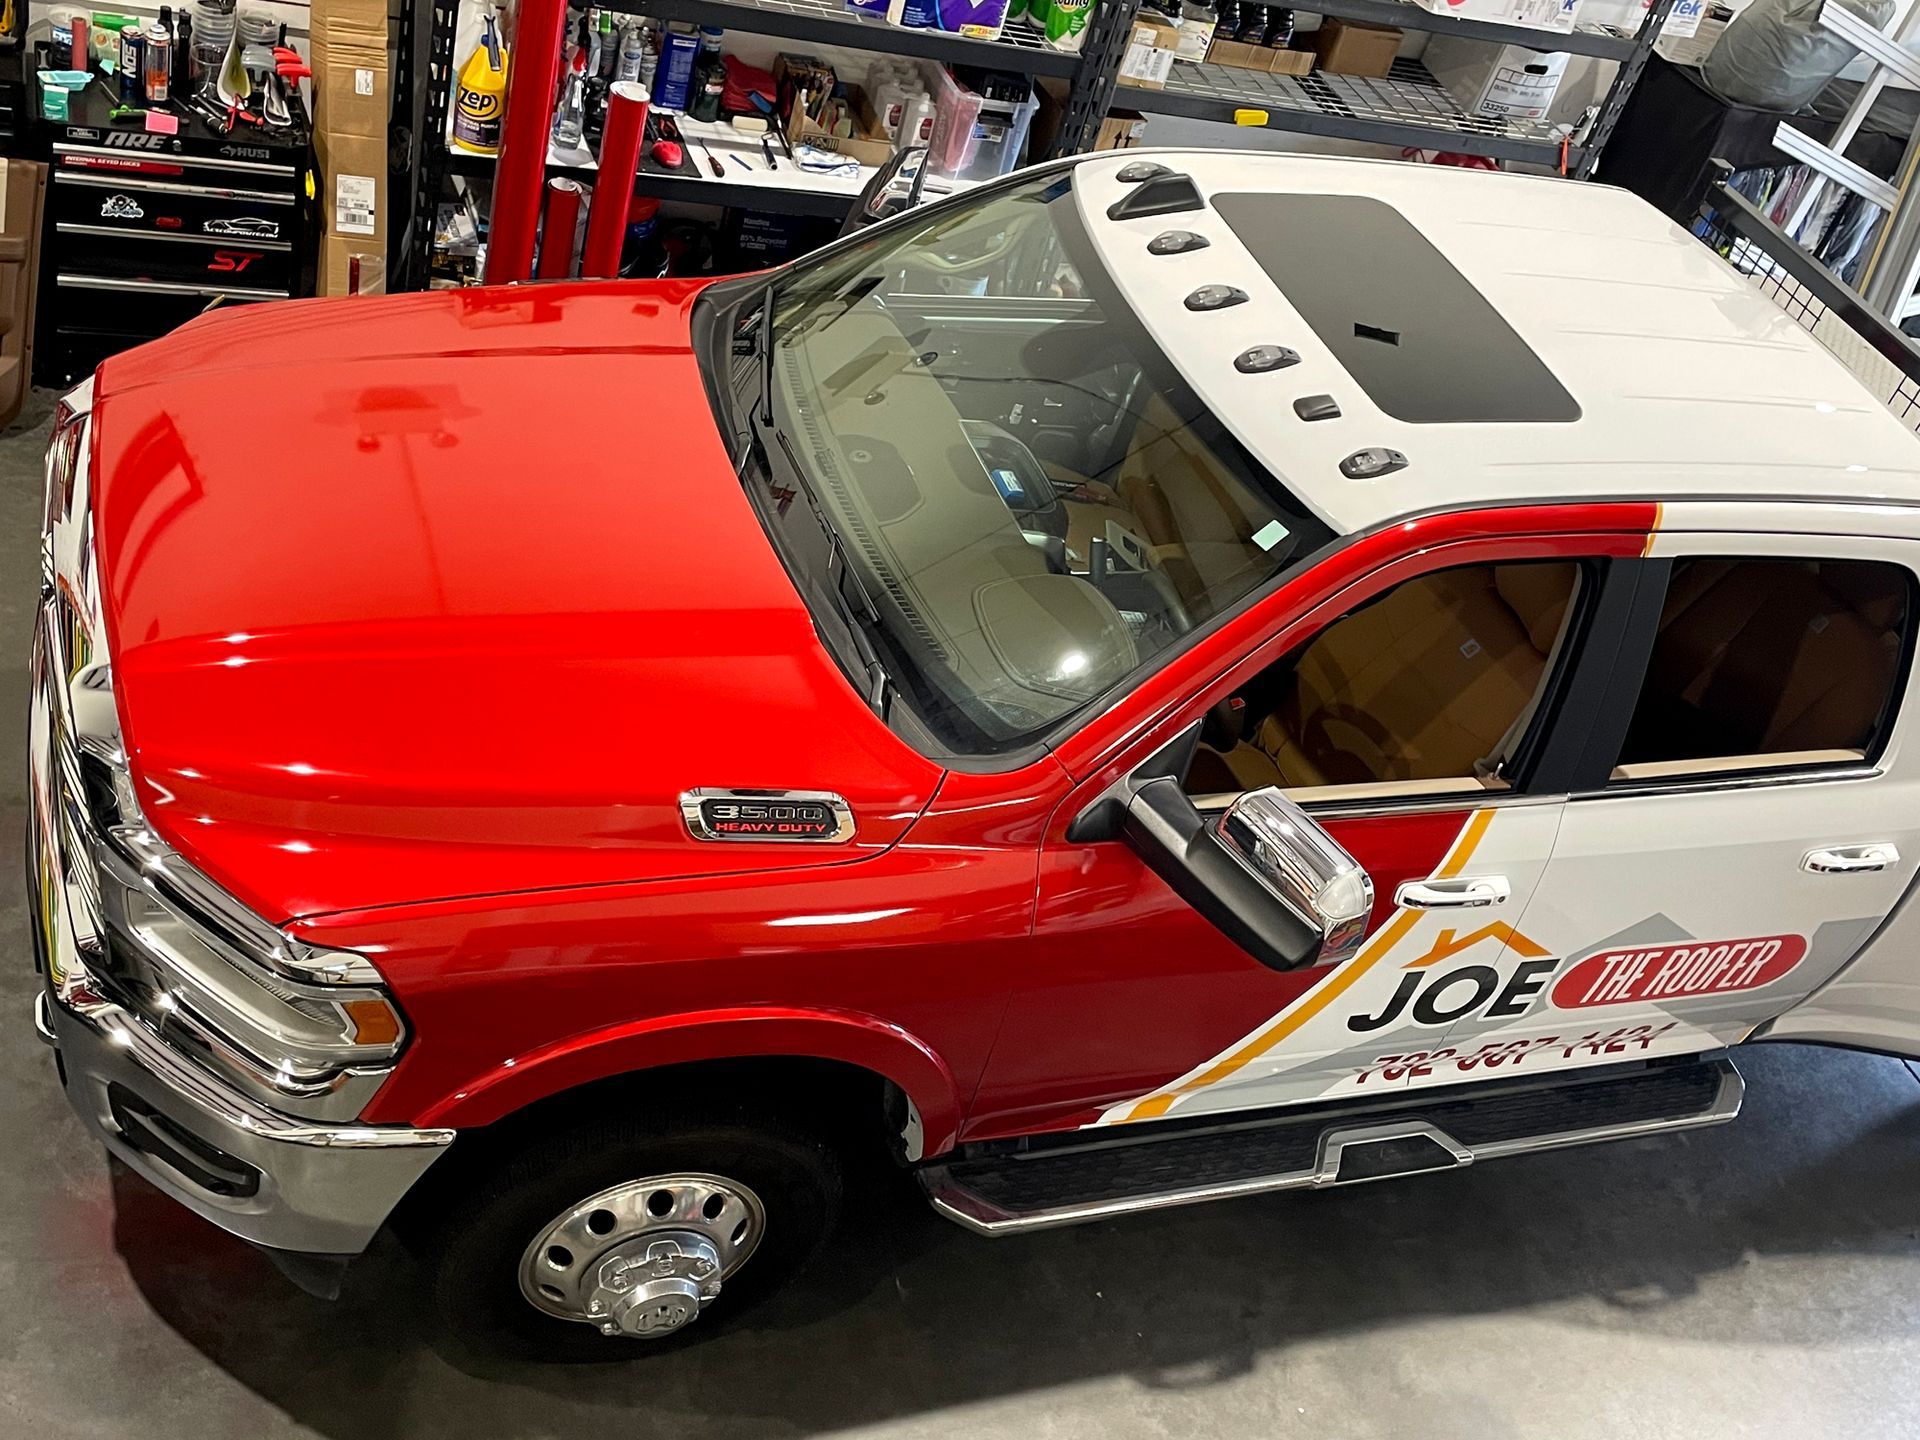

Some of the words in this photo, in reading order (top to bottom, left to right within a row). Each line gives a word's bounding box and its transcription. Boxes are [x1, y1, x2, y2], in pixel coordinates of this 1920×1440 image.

[122, 38, 137, 79] NOS
[711, 805, 823, 820] 3500
[715, 822, 775, 832] HEAVY
[778, 823, 827, 833] DUTY
[1347, 958, 1561, 1032] JOE
[1579, 951, 1665, 1004] THE
[1640, 939, 1783, 997] ROOFER
